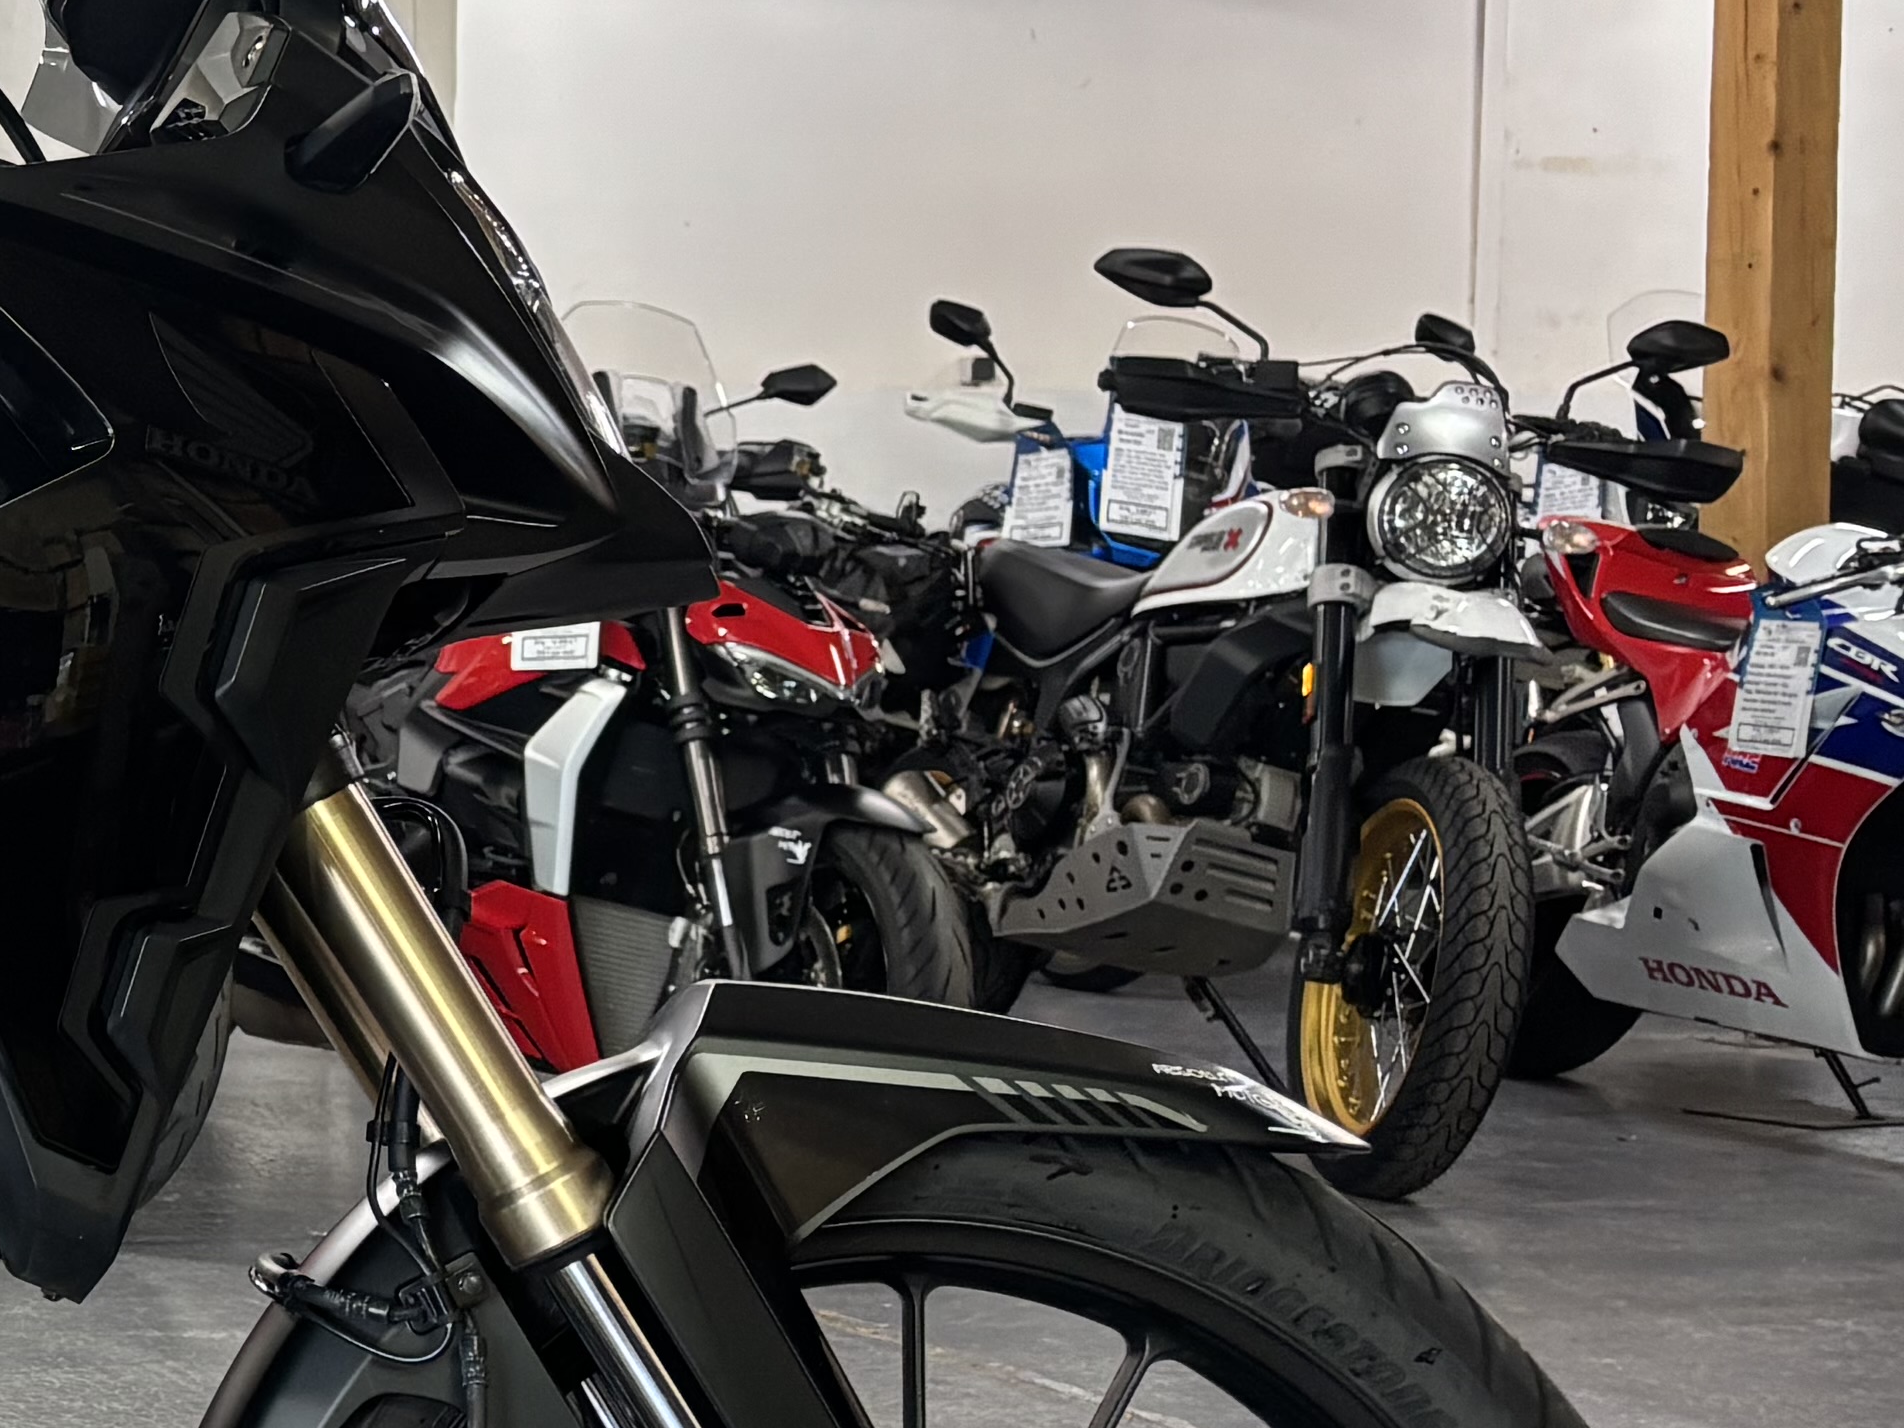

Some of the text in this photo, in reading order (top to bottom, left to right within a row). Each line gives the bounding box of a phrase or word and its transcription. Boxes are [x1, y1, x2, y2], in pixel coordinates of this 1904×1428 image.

[144, 421, 320, 507] HONDA
[1826, 637, 1900, 684] CBR
[1639, 956, 1790, 1008] HONDA
